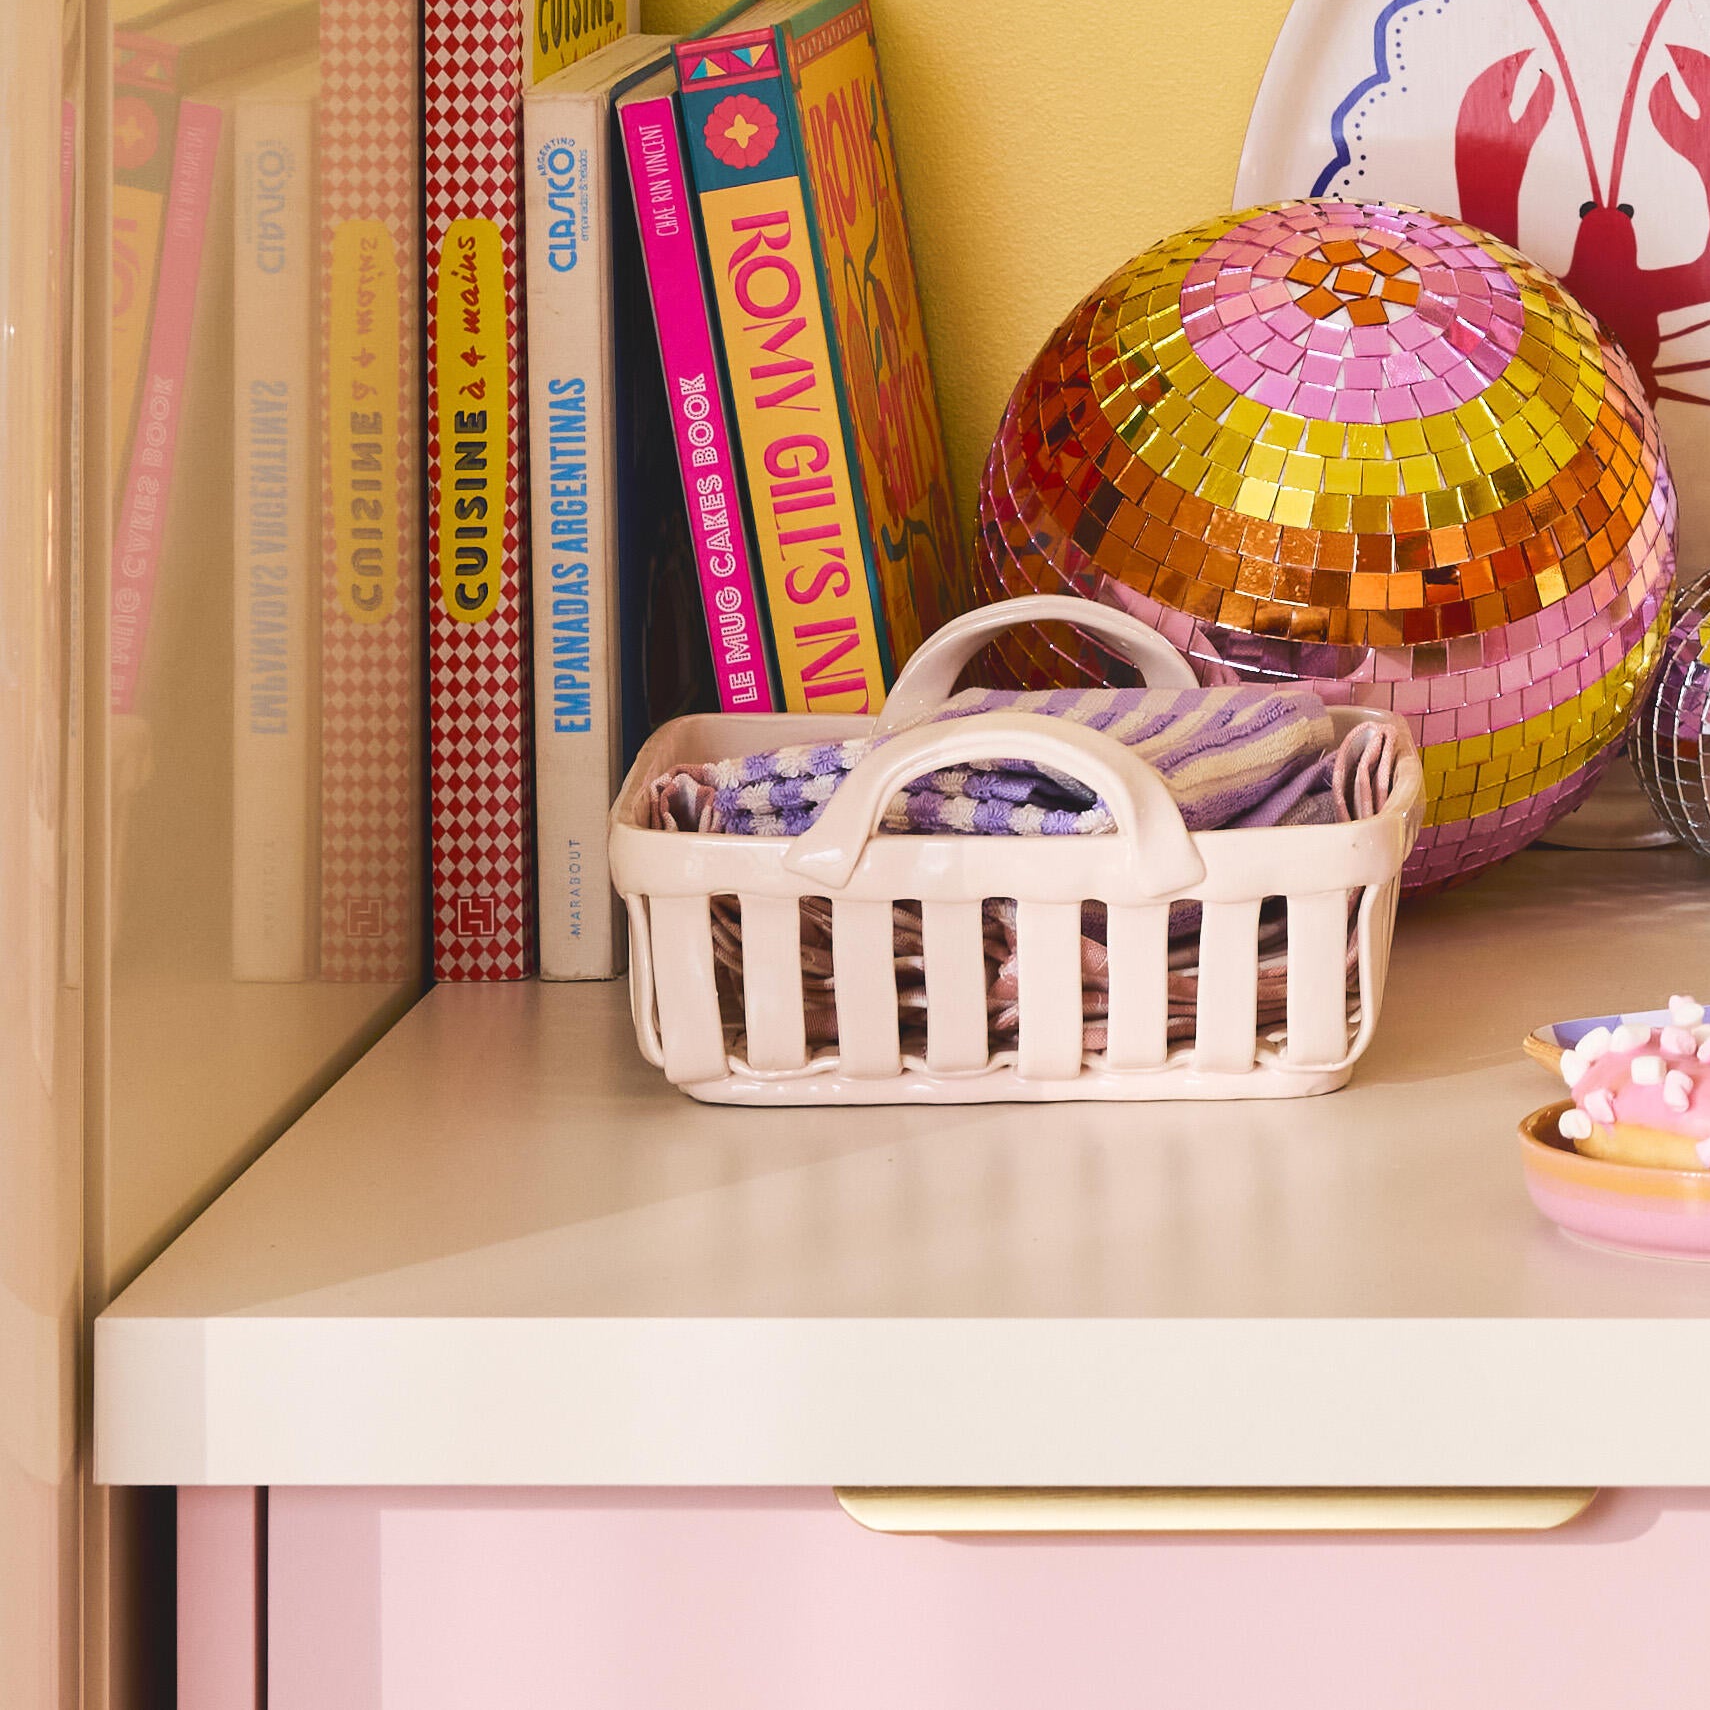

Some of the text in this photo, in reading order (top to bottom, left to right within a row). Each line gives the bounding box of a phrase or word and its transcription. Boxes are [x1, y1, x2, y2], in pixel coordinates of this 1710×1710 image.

[548, 147, 578, 273] CLASICO
[638, 123, 679, 237] CHAE RIN VINCENT
[727, 209, 821, 415] ROMY
[450, 235, 489, 612] CUISINE à 4 mains
[763, 430, 852, 607] GILL'S
[548, 377, 591, 733] EMPANADAS ARGENTINAS
[679, 372, 759, 705] LE MUG CAKES BOOK
[568, 839, 581, 938] MARABOUT
